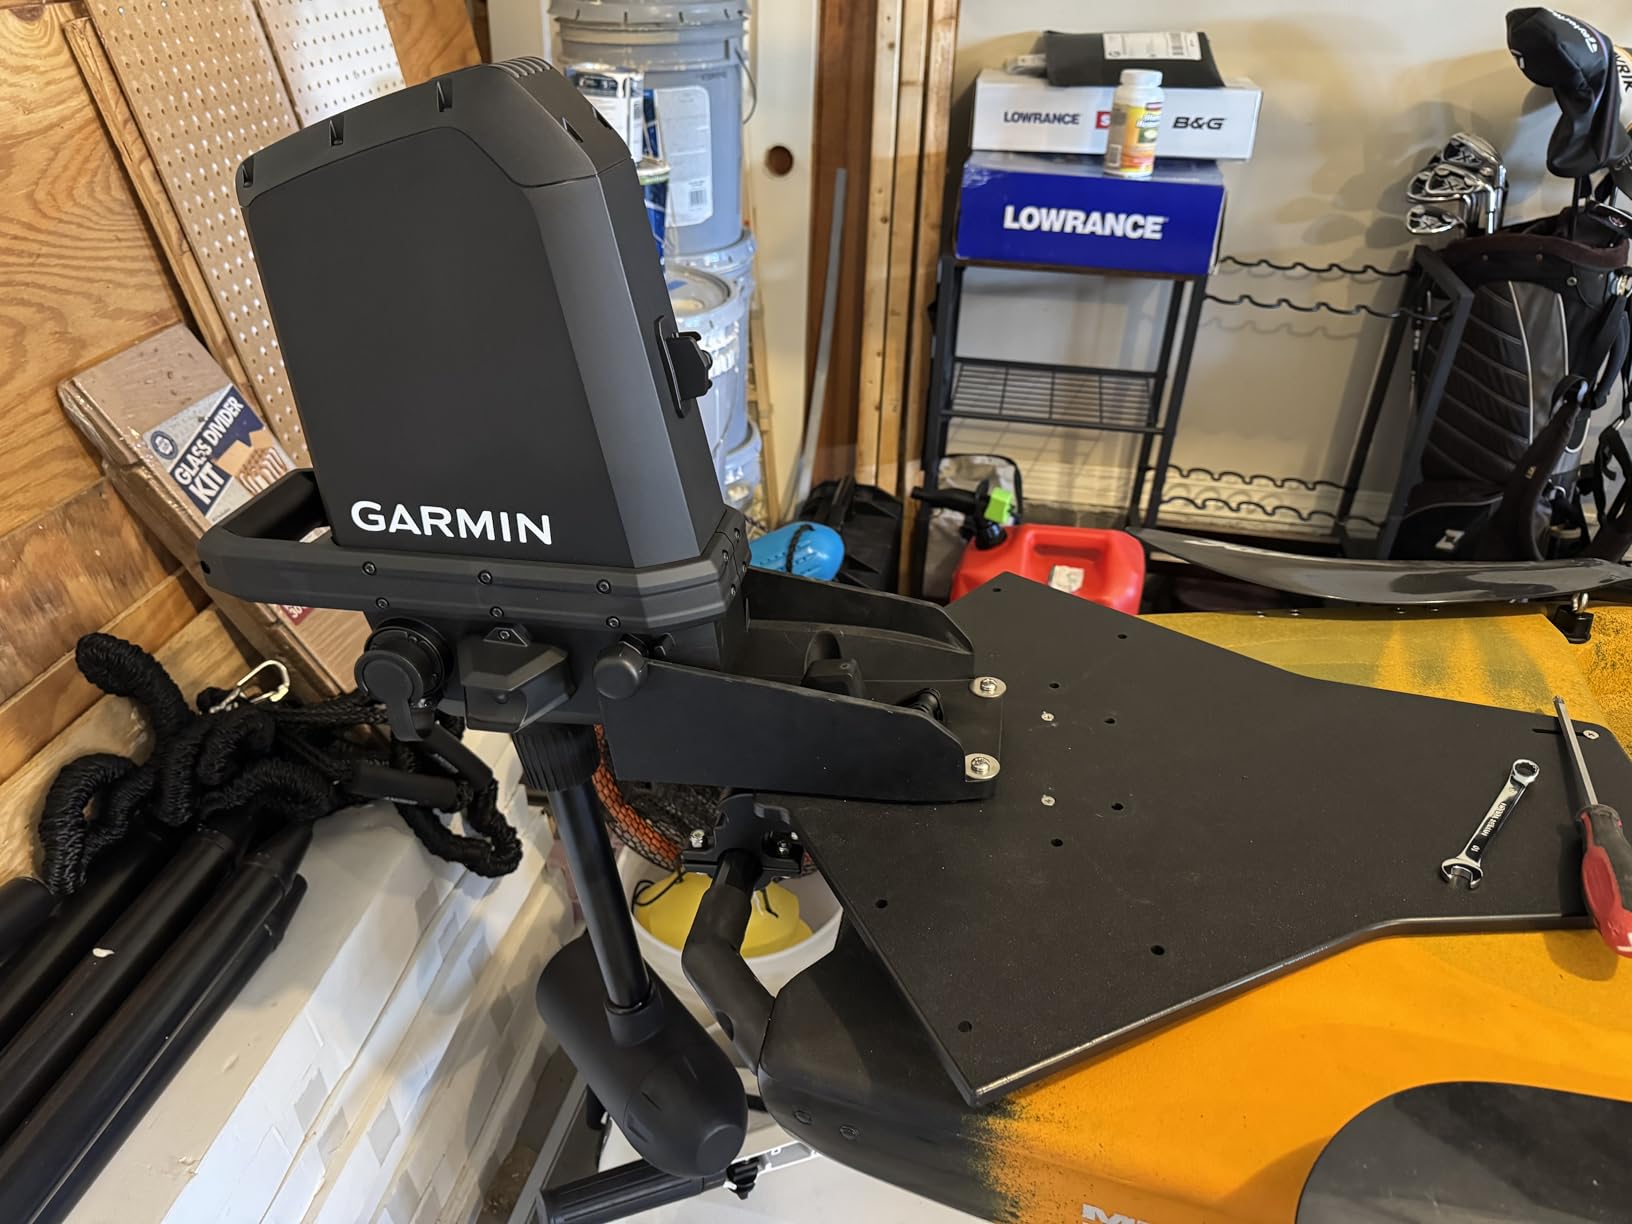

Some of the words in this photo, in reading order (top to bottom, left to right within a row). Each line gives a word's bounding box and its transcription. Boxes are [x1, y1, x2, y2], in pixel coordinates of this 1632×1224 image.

[1003, 111, 1081, 126] LOWRANCE
[1172, 116, 1226, 131] B&G
[1003, 205, 1165, 240] LOWRANCE
[174, 439, 213, 486] GLASS
[202, 396, 245, 447] DIVIDER
[188, 461, 225, 505] KIT
[351, 500, 553, 546] GARMIN
